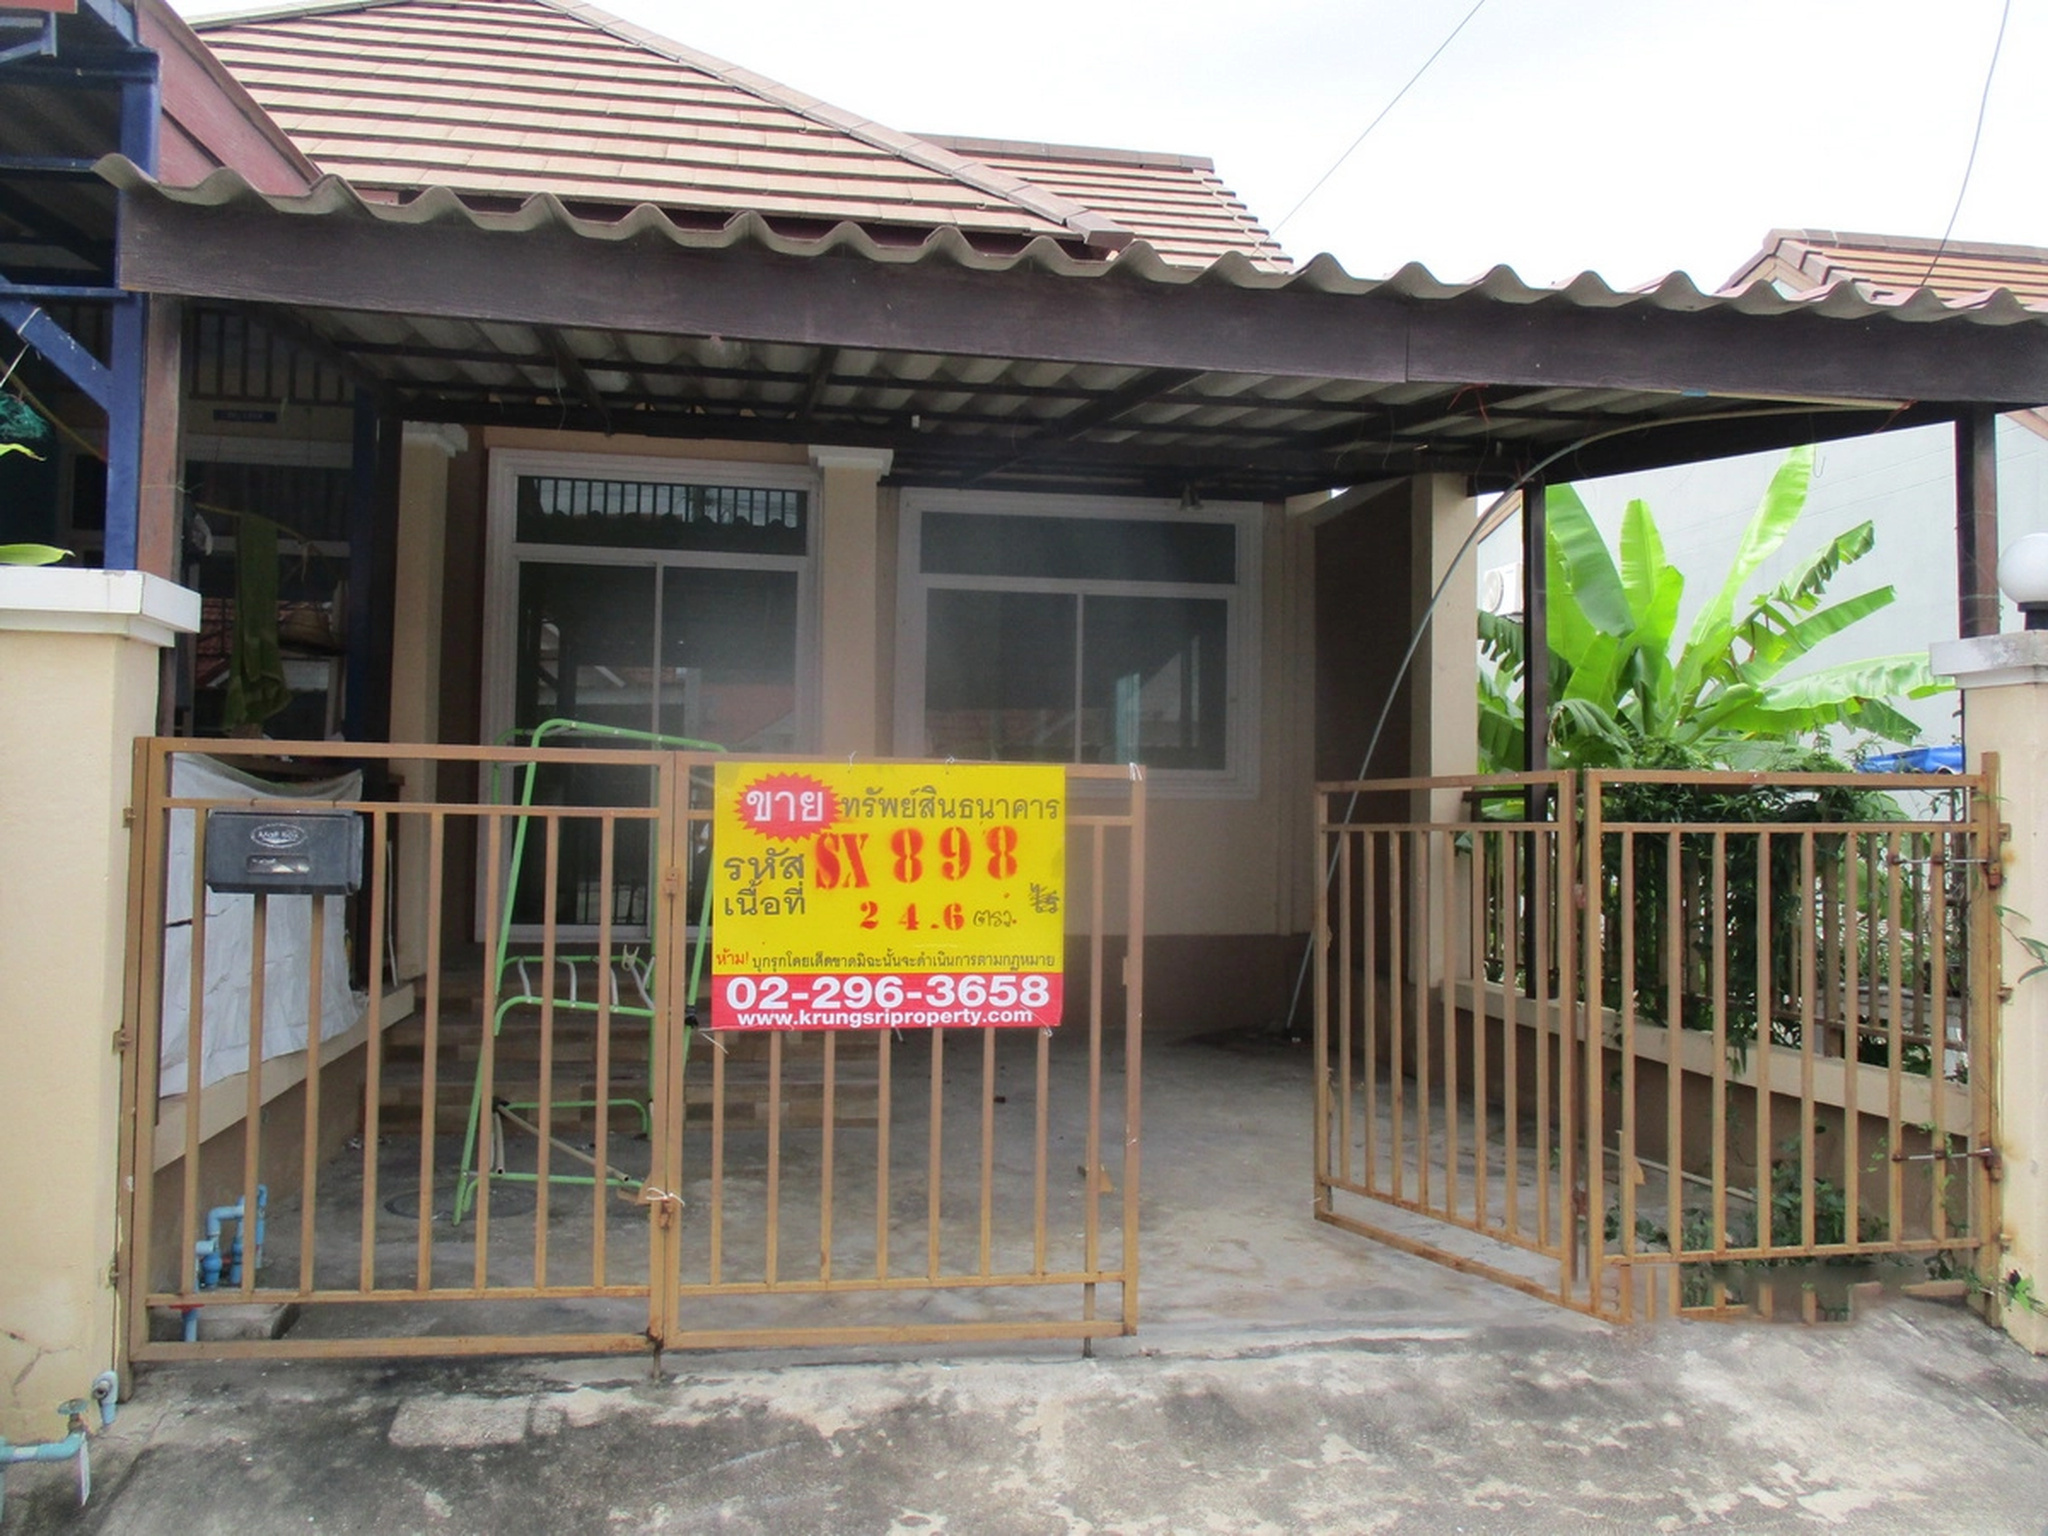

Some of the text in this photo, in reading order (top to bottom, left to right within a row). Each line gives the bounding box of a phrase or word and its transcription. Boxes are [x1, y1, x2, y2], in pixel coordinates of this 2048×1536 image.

[746, 789, 824, 823] ขาย
[841, 784, 1061, 820] ทรัพย์สินธนาคาร
[723, 847, 806, 881] รหัส
[814, 832, 871, 890] SX
[723, 879, 806, 916] เนื้อที่
[715, 947, 749, 966] ห้าม!
[725, 974, 1051, 1010] 02-296-3658
[737, 1007, 1034, 1029] www.krungsriproperty.com
